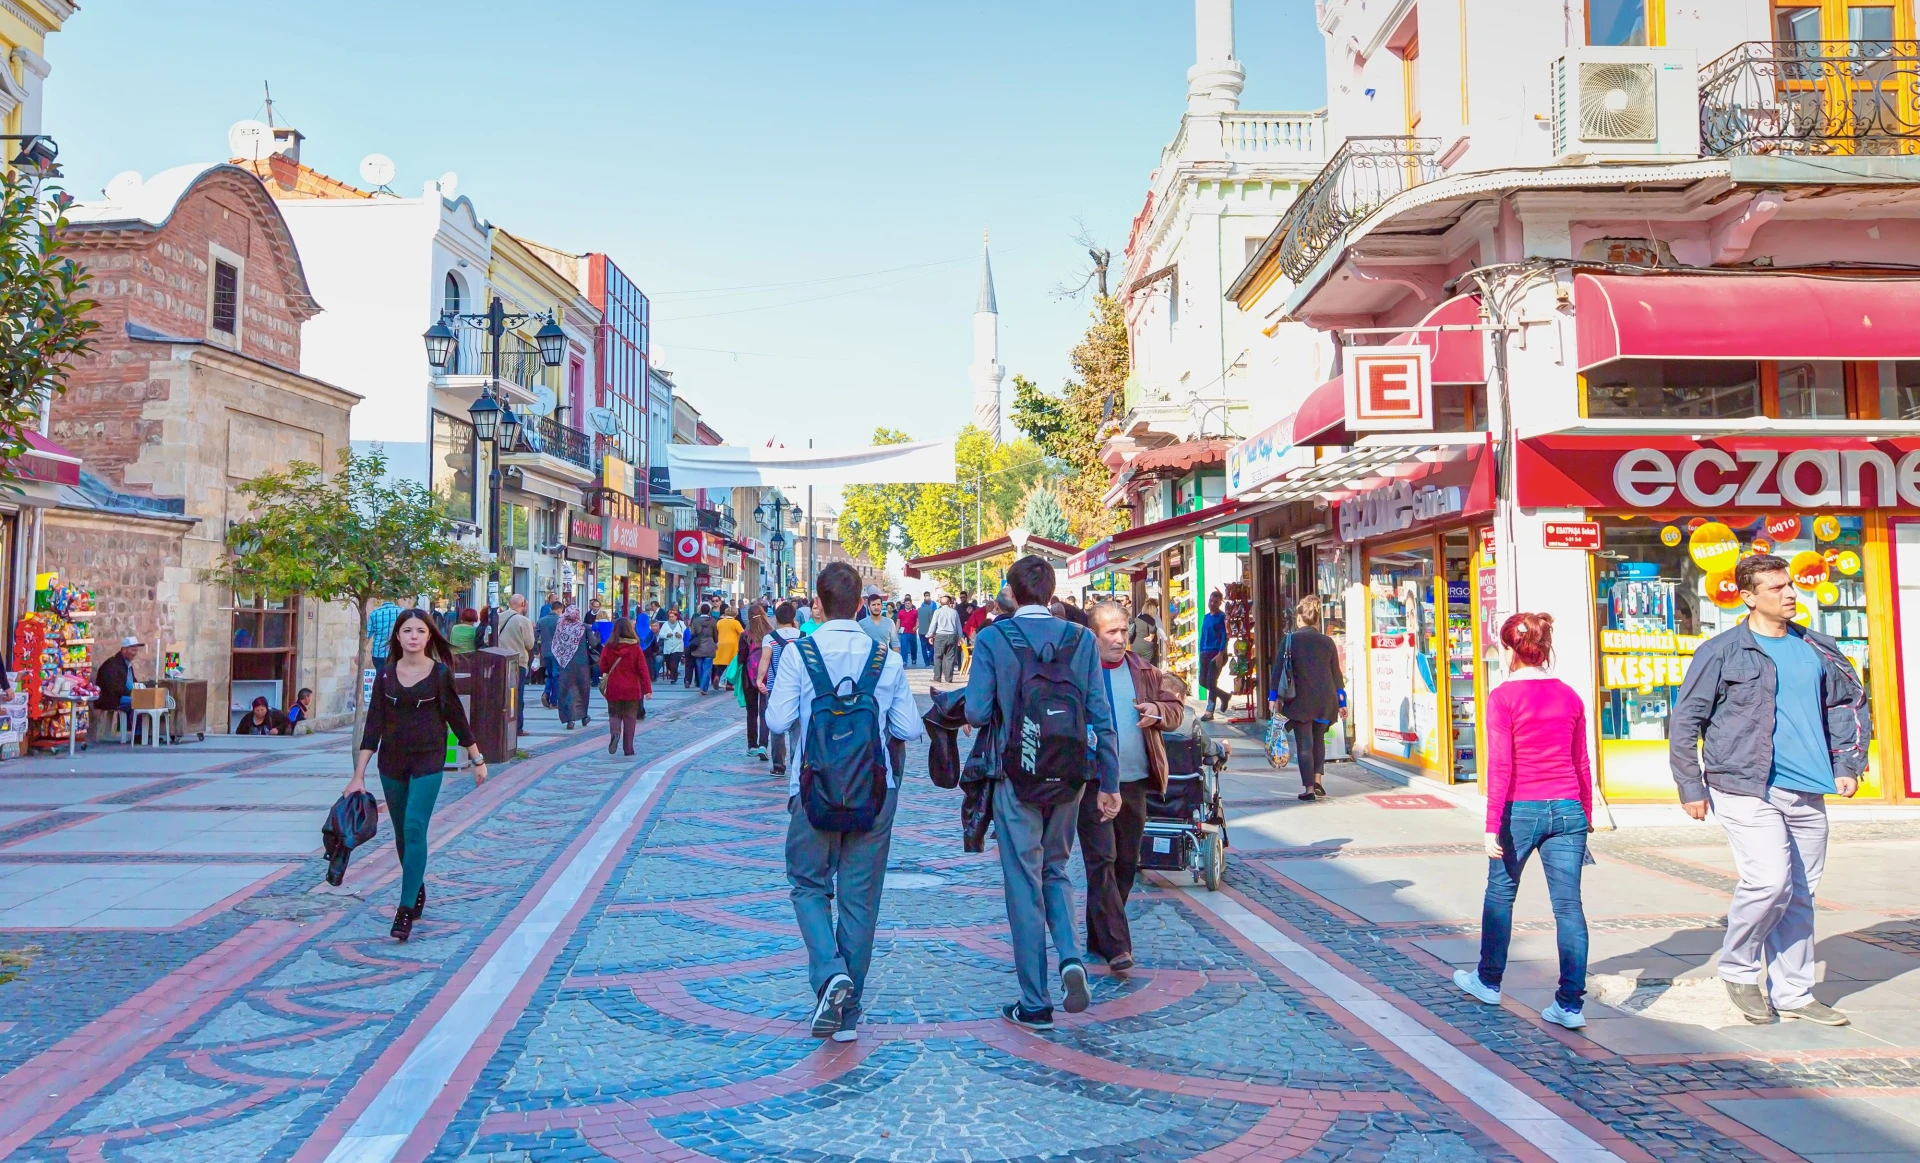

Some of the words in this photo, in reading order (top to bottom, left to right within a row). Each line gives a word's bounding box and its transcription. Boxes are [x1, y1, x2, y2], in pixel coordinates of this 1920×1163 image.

[1369, 364, 1411, 411] E
[1339, 480, 1414, 543] eczane
[1767, 518, 1796, 534] CoQ10
[1821, 521, 1835, 536] K
[1664, 531, 1679, 542] B6
[1692, 538, 1739, 560] Niasin
[1839, 557, 1857, 570] B2
[1794, 572, 1828, 585] CoQ10
[1719, 580, 1739, 593] Co
[1603, 628, 1676, 649] KENDİNİZİ
